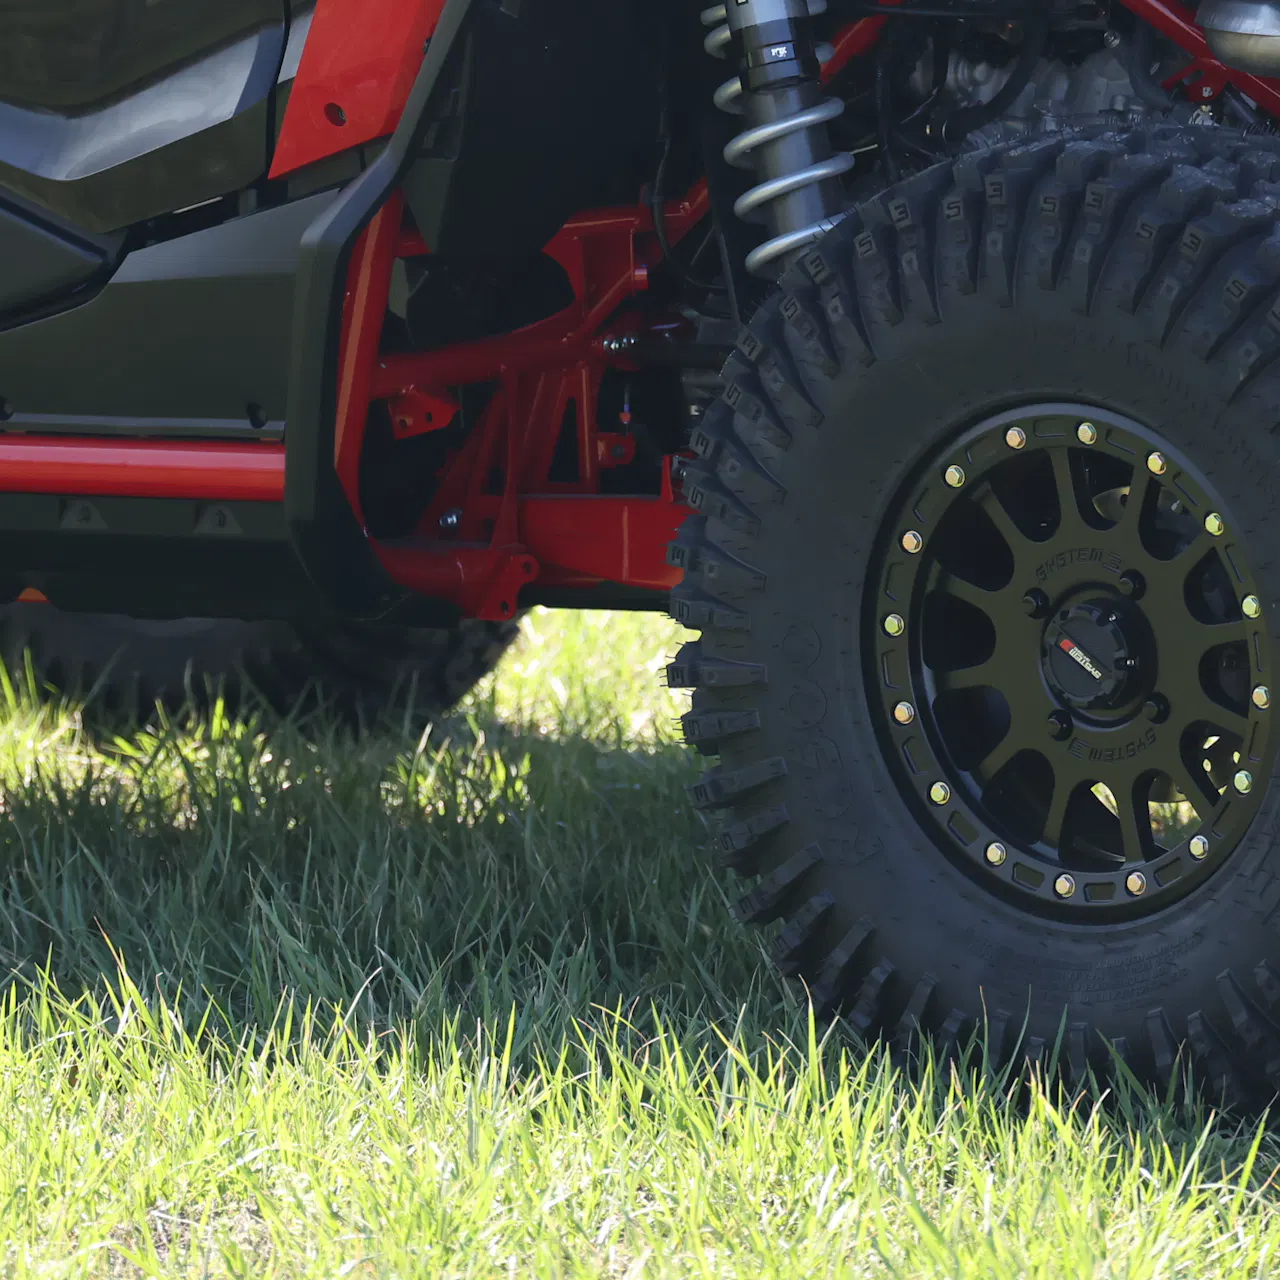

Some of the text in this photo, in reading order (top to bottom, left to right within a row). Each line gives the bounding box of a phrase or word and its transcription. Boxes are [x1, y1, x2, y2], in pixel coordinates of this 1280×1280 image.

[1034, 547, 1104, 582] SYSTEM
[1067, 647, 1103, 680] SYSTEM
[1087, 727, 1157, 763] SYSTEM
